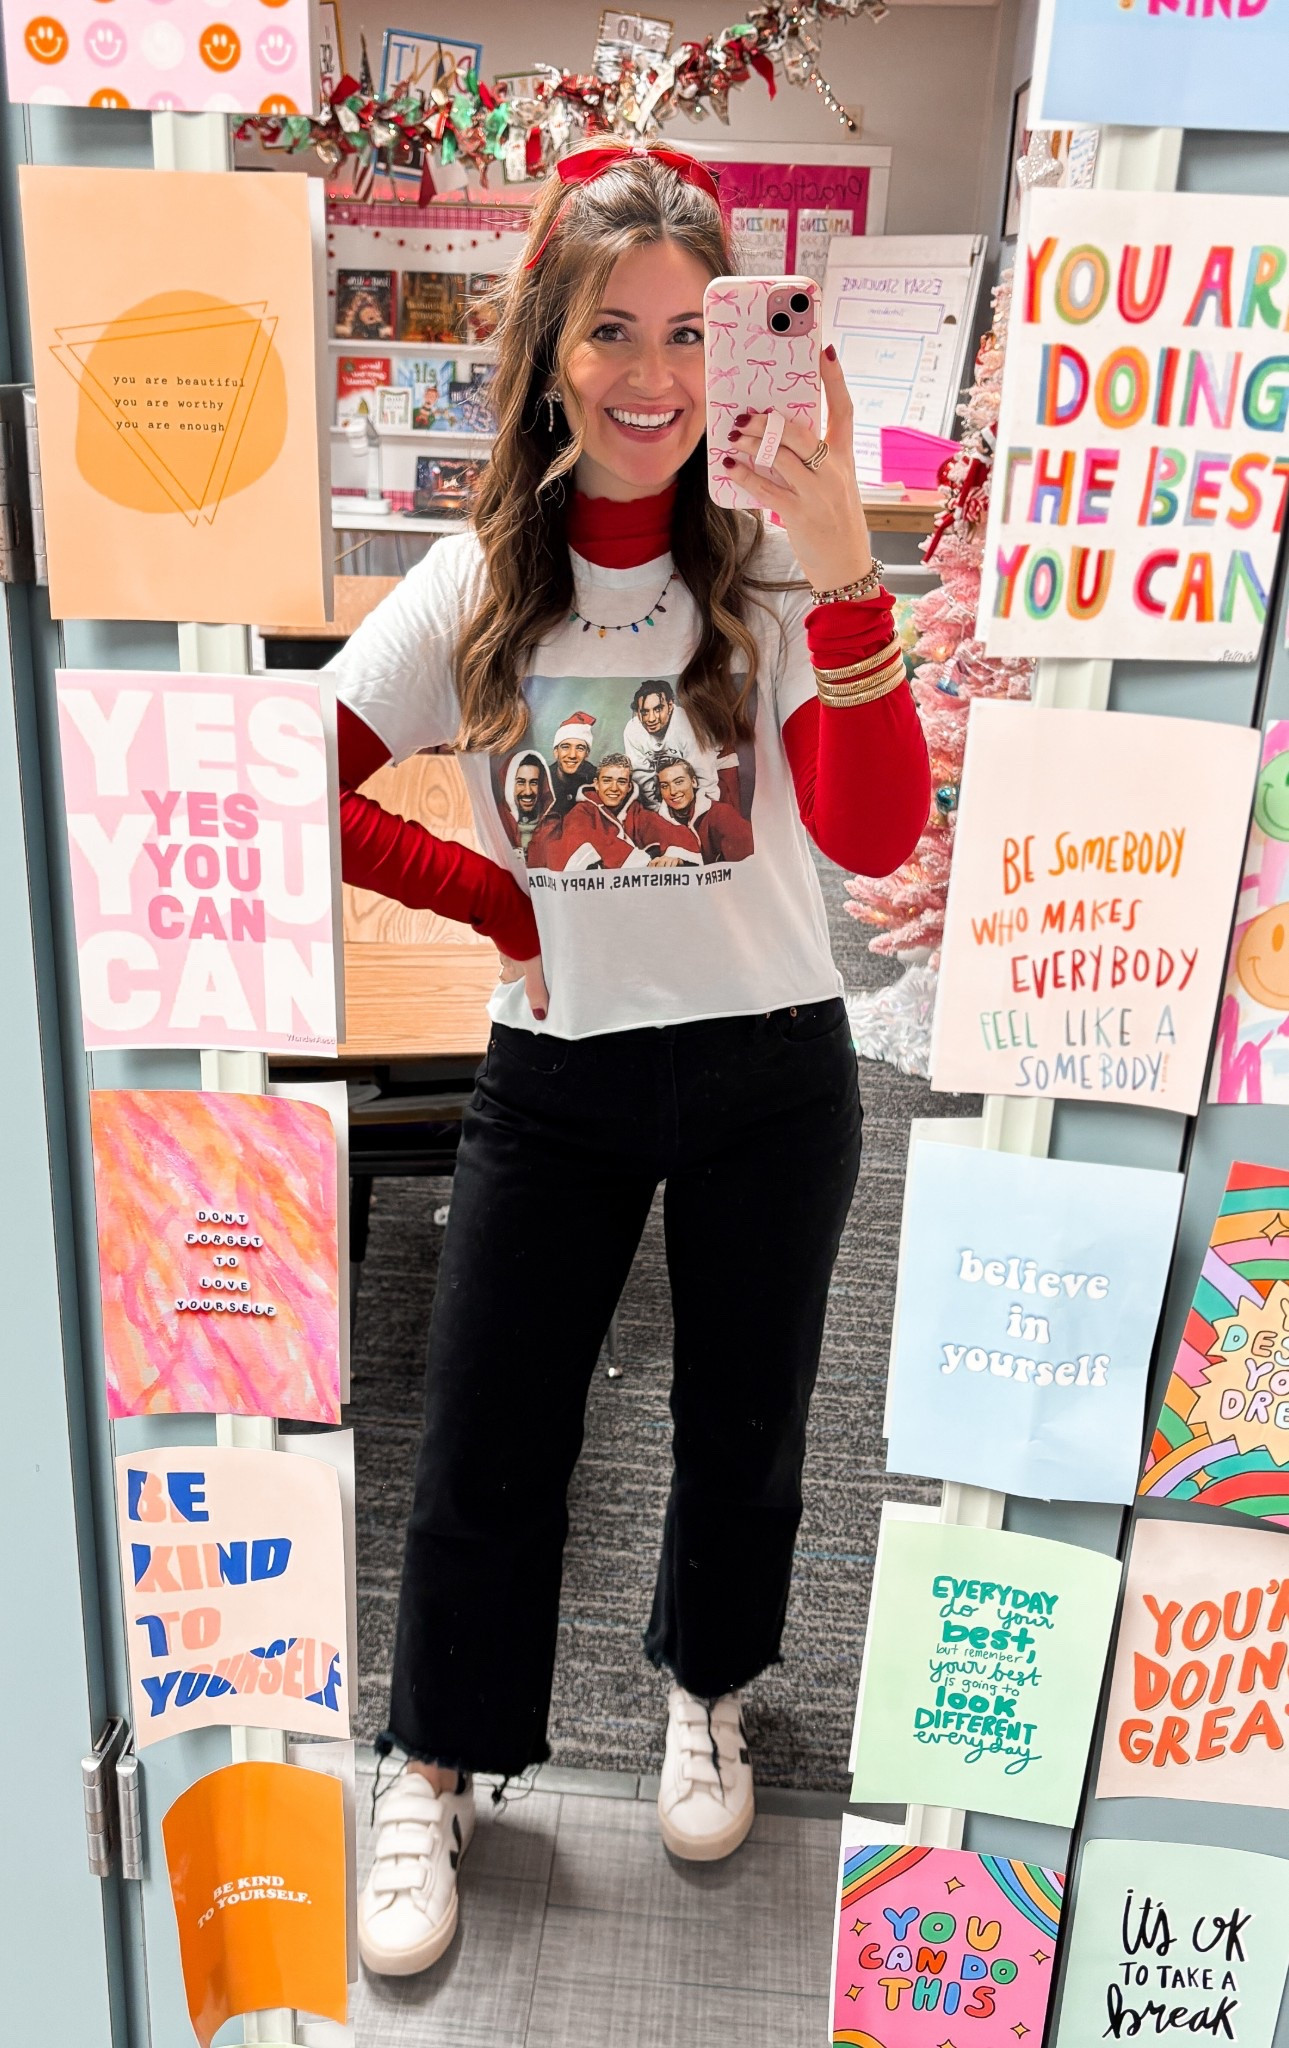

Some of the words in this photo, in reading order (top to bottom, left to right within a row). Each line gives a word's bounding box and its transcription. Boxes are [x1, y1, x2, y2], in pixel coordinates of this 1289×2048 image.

[1022, 236, 1173, 325] YOU
[1182, 244, 1289, 333] AR
[112, 375, 136, 386] you
[145, 376, 168, 385] are
[176, 375, 246, 388] beautiful
[1036, 343, 1289, 433] DOING
[114, 398, 137, 408] you
[146, 399, 169, 408] are
[177, 399, 224, 412] worthy
[116, 420, 139, 431] you
[147, 421, 170, 430] are
[179, 421, 225, 433] enough
[1001, 446, 1121, 526] THE
[993, 544, 1115, 621] YOU
[1132, 548, 1270, 624] CAN
[58, 688, 328, 807] YES
[141, 789, 260, 841] YES
[142, 843, 262, 892] YOU
[1003, 835, 1036, 896] BE
[147, 894, 267, 943] CAN
[971, 906, 1028, 947] WHO
[1040, 898, 1143, 934] MAKES
[80, 929, 337, 1035] CAN
[1011, 945, 1199, 999] EVERYBODY
[979, 1009, 1039, 1051] FEEL
[1065, 1007, 1132, 1049] LIKE
[1155, 1004, 1177, 1045] A
[1015, 1051, 1171, 1093] SOMEBODY!
[197, 1210, 247, 1224] DONT
[186, 1232, 261, 1247] FORGET
[215, 1256, 237, 1267] TO
[201, 1278, 249, 1291] LOVE
[958, 1248, 1110, 1300] believe
[176, 1300, 276, 1314] YOURSELF
[1006, 1302, 1051, 1344] in
[940, 1343, 1111, 1387] yourself
[127, 1468, 210, 1523] BE
[131, 1537, 292, 1593] KIND
[932, 1575, 1059, 1616] EVERYDAY
[939, 1597, 979, 1618] do
[997, 1608, 1055, 1630] your
[135, 1606, 221, 1657] TO
[936, 1643, 959, 1655] but
[964, 1648, 1024, 1664] remember
[141, 1637, 342, 1718] YOURSELF
[929, 1659, 987, 1683] your
[987, 1662, 1043, 1687] best
[944, 1674, 955, 1687] is
[962, 1678, 998, 1697] going
[1001, 1681, 1020, 1697] to
[1133, 1641, 1289, 1712] DOIN
[914, 1707, 1038, 1745] DIFFERENT
[1118, 1699, 1289, 1768] GREA
[913, 1731, 1043, 1775] everyday
[197, 1907, 215, 1929] TO
[215, 1888, 312, 1910] YOURSELF.
[213, 1881, 235, 1902] BE
[237, 1875, 285, 1890] KIND
[882, 1906, 1002, 1952] YOU
[858, 1942, 948, 1975] CAN
[960, 1953, 1019, 1985] DO
[1118, 1961, 1149, 1986] TO
[1156, 1965, 1214, 1989] TAKE
[1221, 1970, 1237, 1991] A
[878, 1975, 996, 2019] THIS
[1102, 1983, 1238, 2040] break
